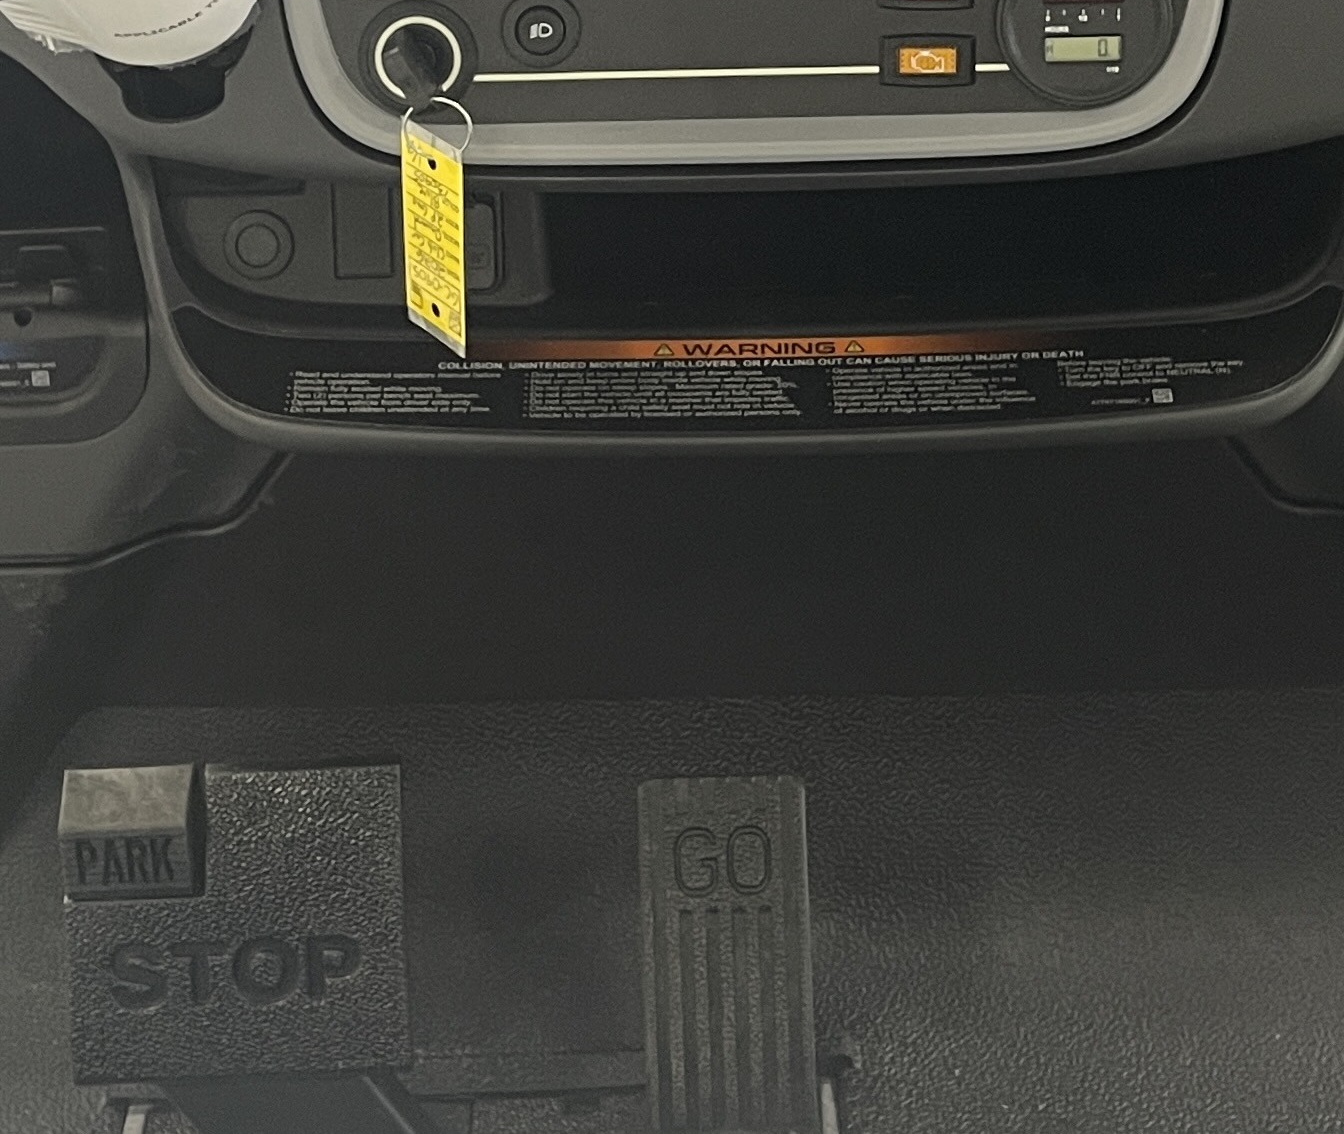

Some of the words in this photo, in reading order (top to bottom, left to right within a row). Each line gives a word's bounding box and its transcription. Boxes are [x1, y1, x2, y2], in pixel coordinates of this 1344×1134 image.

[509, 362, 586, 370] UNINTENDED
[743, 359, 761, 368] OR
[764, 358, 815, 367] FALLING
[818, 358, 843, 366] OUT
[845, 357, 872, 365] CAN
[874, 356, 916, 364] CAUSE
[919, 355, 973, 363] SERIOUS
[975, 353, 1018, 361] INJURY
[1022, 352, 1040, 360] OR
[1043, 350, 1084, 359] DEATH
[682, 342, 837, 357] WARNING
[75, 834, 177, 886] PARK
[672, 824, 774, 897] GO
[110, 931, 364, 1009] STOP
